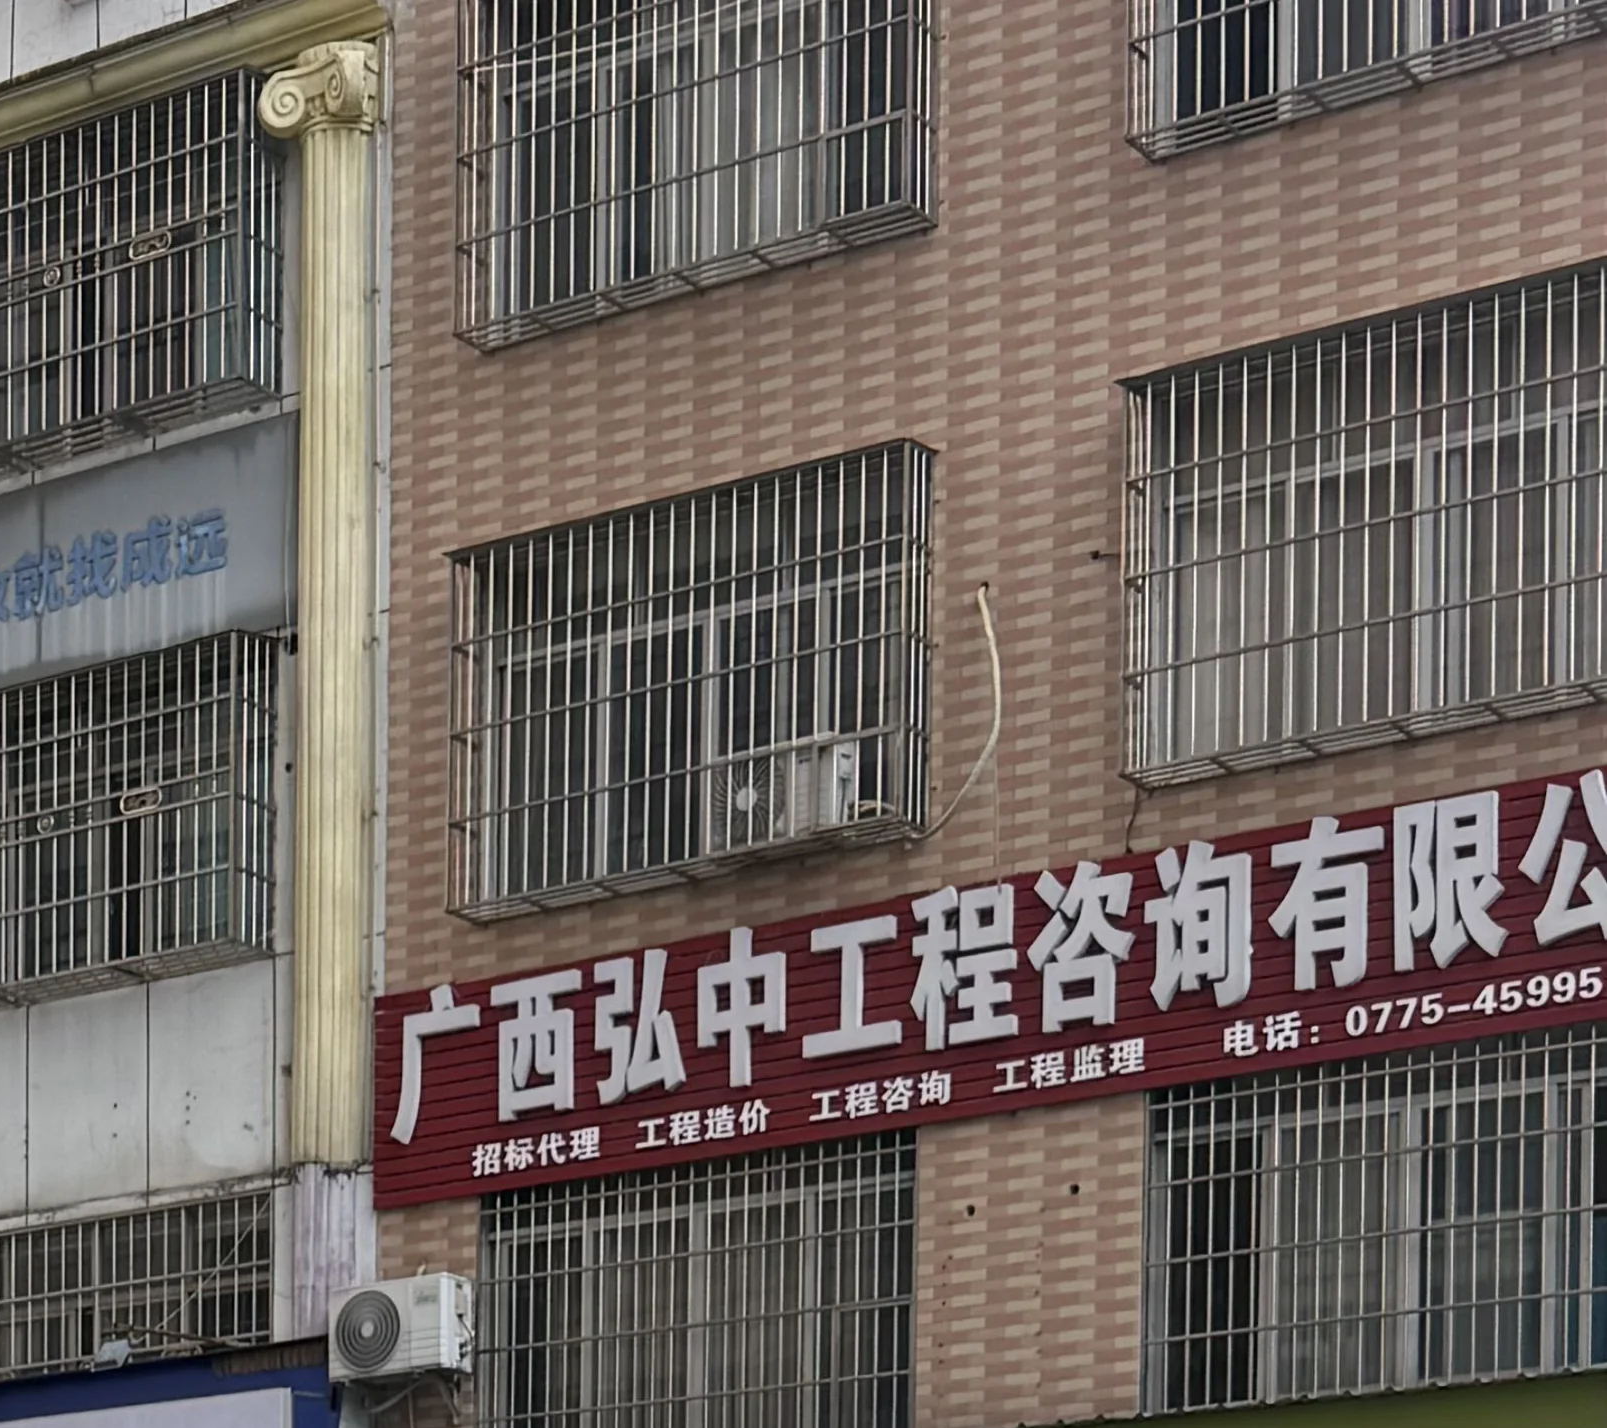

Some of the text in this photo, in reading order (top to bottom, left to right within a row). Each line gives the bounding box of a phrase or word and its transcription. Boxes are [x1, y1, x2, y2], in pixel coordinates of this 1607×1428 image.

[390, 768, 1607, 1145] 广西弘中工程咨询有限公
[471, 1125, 602, 1177] 招标代理
[635, 1097, 771, 1150] 工程造价
[808, 1069, 953, 1122] 工程咨询
[992, 1036, 1147, 1093] 工程监理
